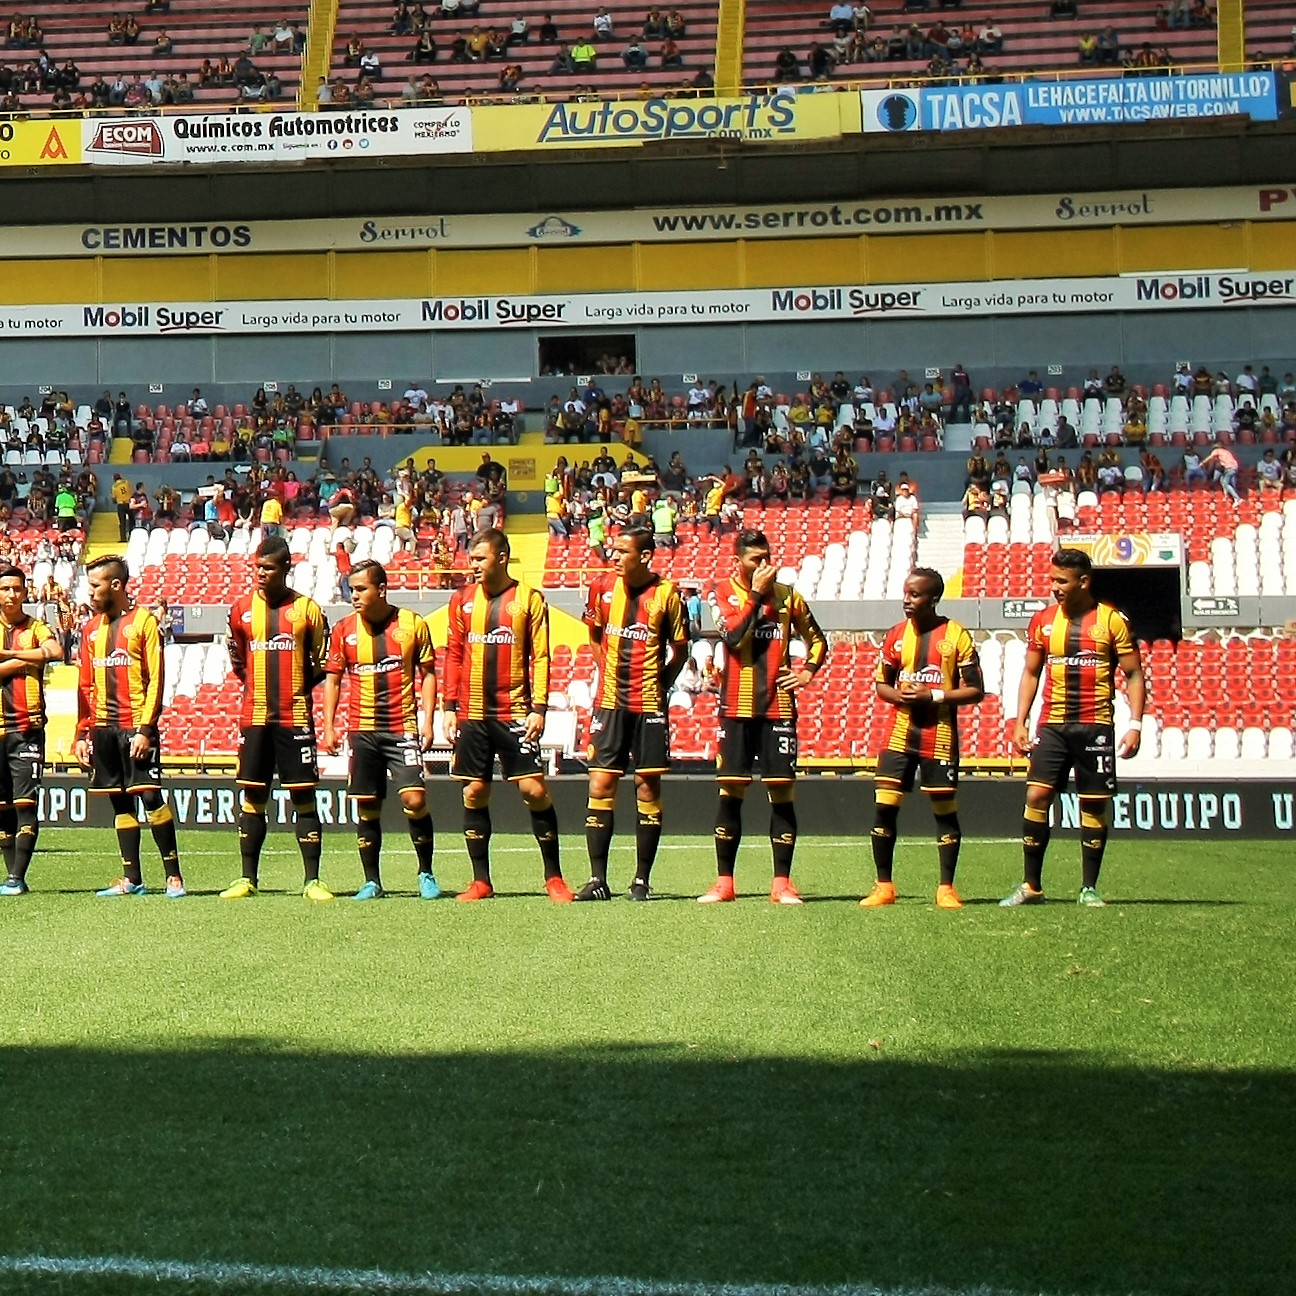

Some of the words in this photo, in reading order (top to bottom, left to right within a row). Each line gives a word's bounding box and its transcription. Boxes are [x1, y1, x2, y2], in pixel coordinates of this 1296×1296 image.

[1174, 76, 1270, 101] TORNILLO?
[926, 91, 1022, 129] TACSA
[102, 126, 152, 144] ECOM
[173, 116, 262, 139] Químicos
[269, 113, 399, 136] Automotrices
[652, 202, 983, 232] www.serrot.com.mx
[81, 225, 251, 249] CEMENTOS
[771, 289, 841, 311] Mobil
[848, 290, 922, 311] Super
[942, 296, 981, 310] Larga
[985, 295, 1013, 306] vida
[1017, 294, 1048, 308] para
[1070, 292, 1114, 303] motor
[1137, 279, 1209, 301] Mobil
[1218, 278, 1294, 298] Super
[83, 307, 149, 327] Mobil
[156, 308, 223, 331] Super
[241, 313, 278, 327] Larga
[281, 313, 308, 324] vida
[312, 313, 342, 326] para
[361, 312, 401, 323] motor
[421, 300, 489, 321] Mobil
[496, 301, 566, 323] Super
[585, 305, 622, 317] Larga
[626, 305, 654, 316] vida
[658, 305, 688, 318] para
[709, 302, 750, 313] motor
[24, 318, 63, 329] motor
[1115, 537, 1133, 559] 9
[779, 737, 797, 754] 33
[1113, 793, 1243, 830] EQUIPO
